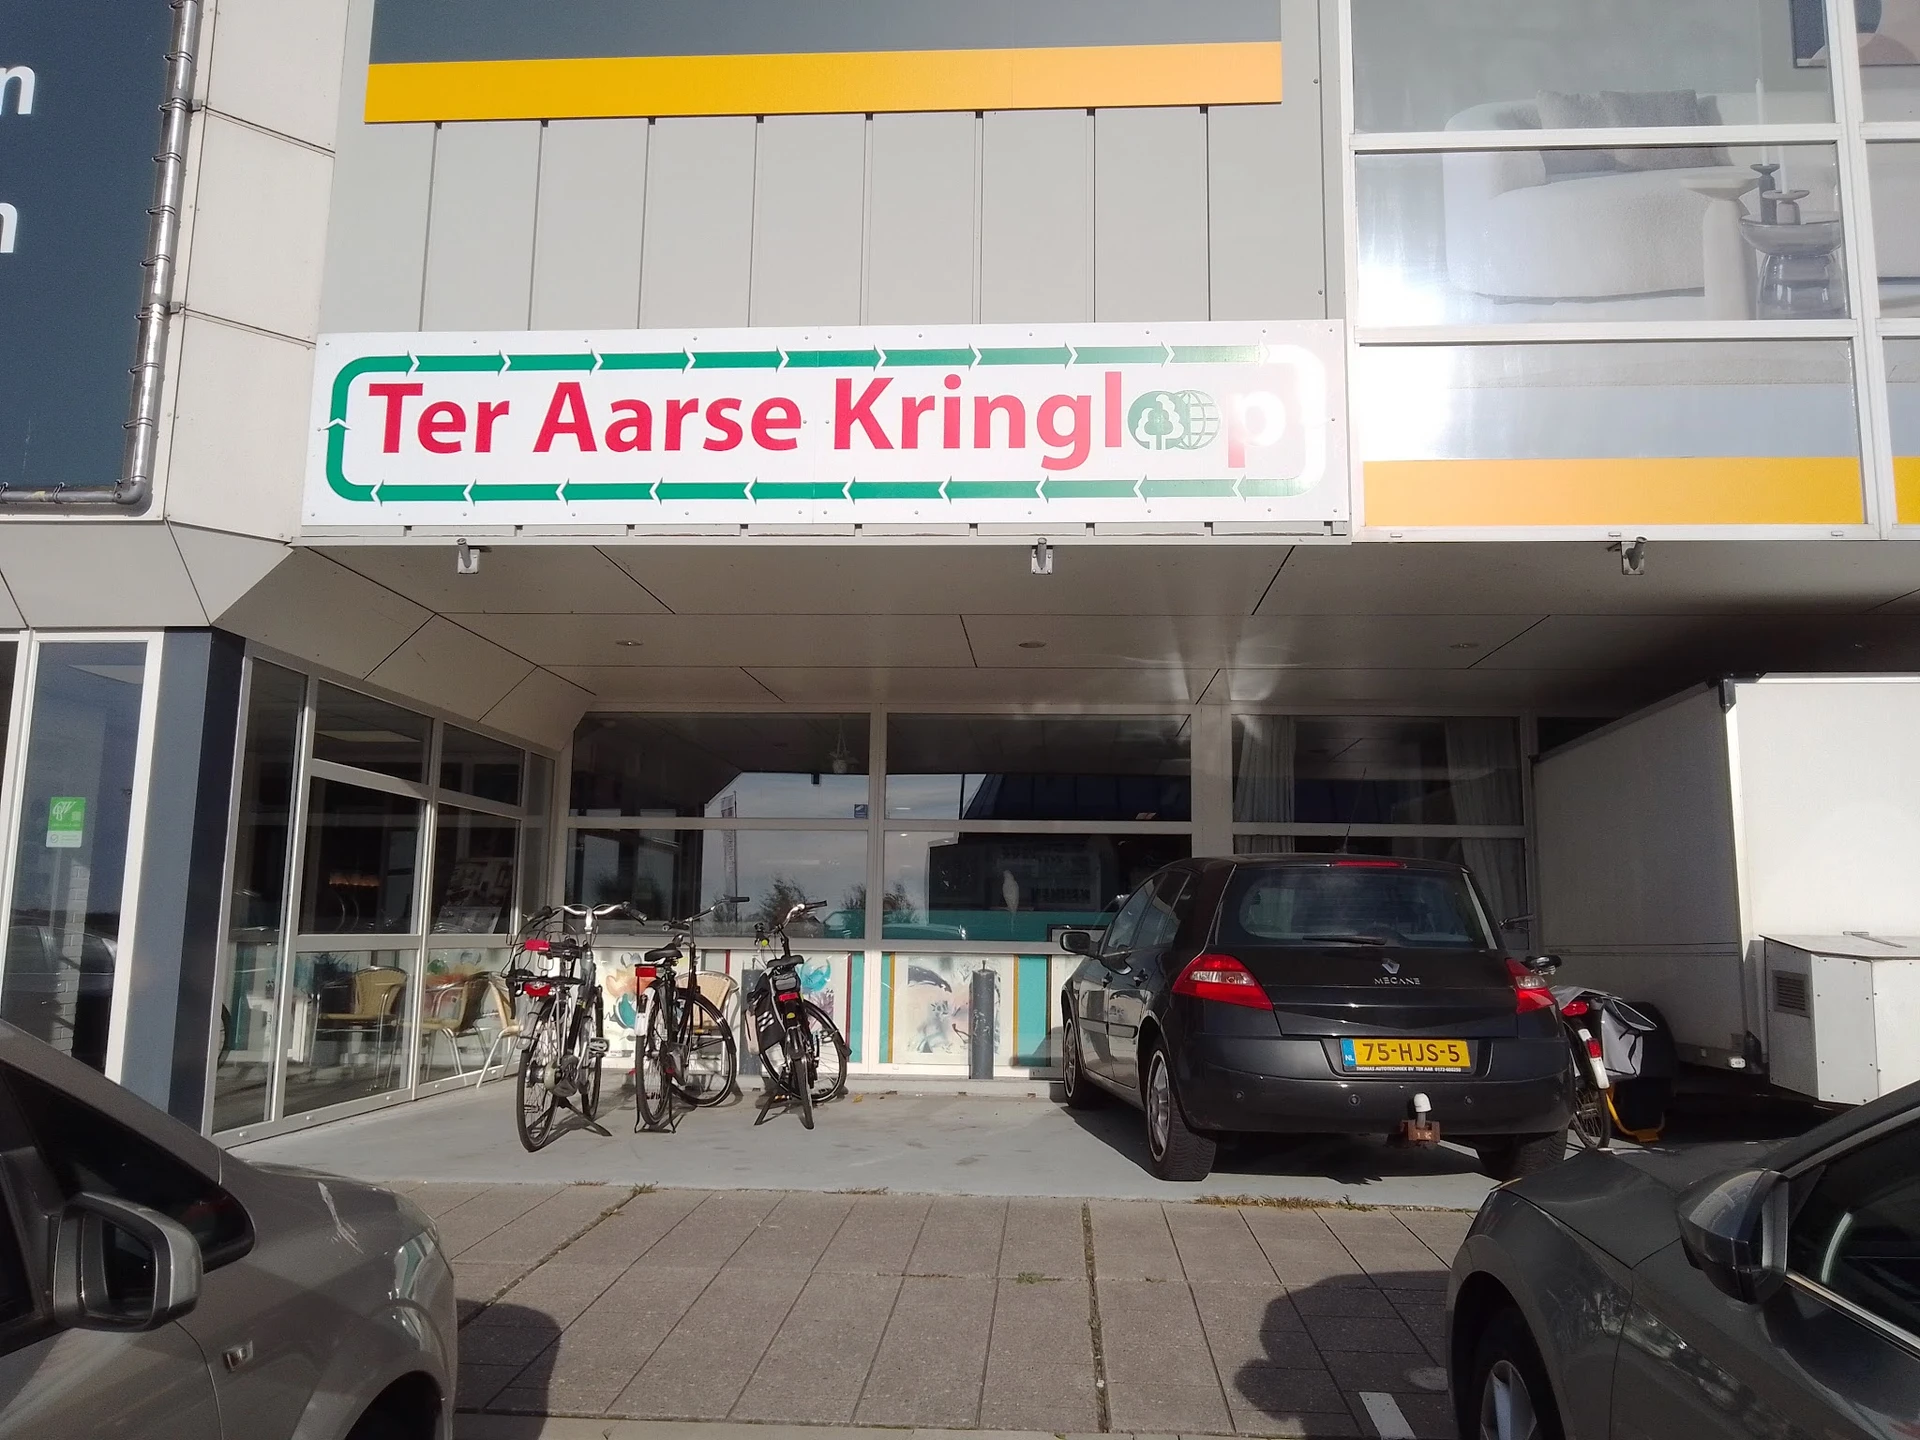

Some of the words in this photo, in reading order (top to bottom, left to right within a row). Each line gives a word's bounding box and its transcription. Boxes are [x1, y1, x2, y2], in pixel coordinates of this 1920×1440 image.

[369, 382, 510, 454] Ter
[532, 381, 802, 453] Aarse
[1362, 1043, 1461, 1063] 75-HJS-5
